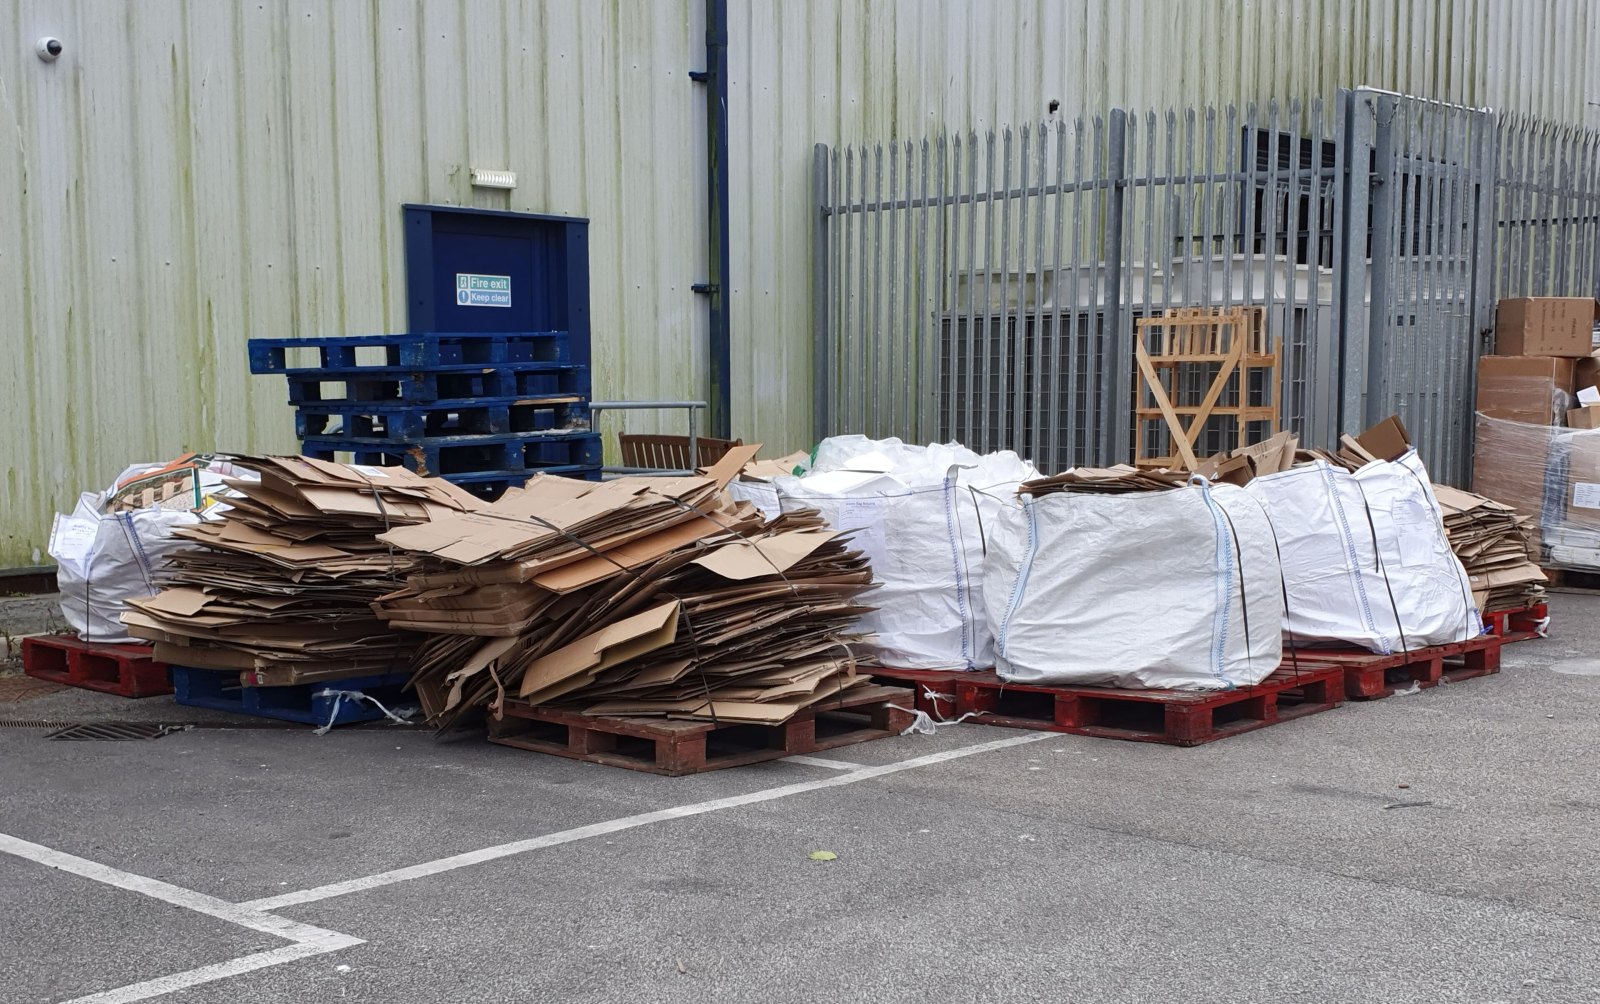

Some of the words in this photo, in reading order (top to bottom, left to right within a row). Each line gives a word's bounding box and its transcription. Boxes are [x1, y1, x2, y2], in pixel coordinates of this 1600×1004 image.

[471, 277, 488, 288] Fire
[490, 278, 507, 289] exit
[471, 292, 489, 303] Keep
[491, 293, 508, 303] clear
